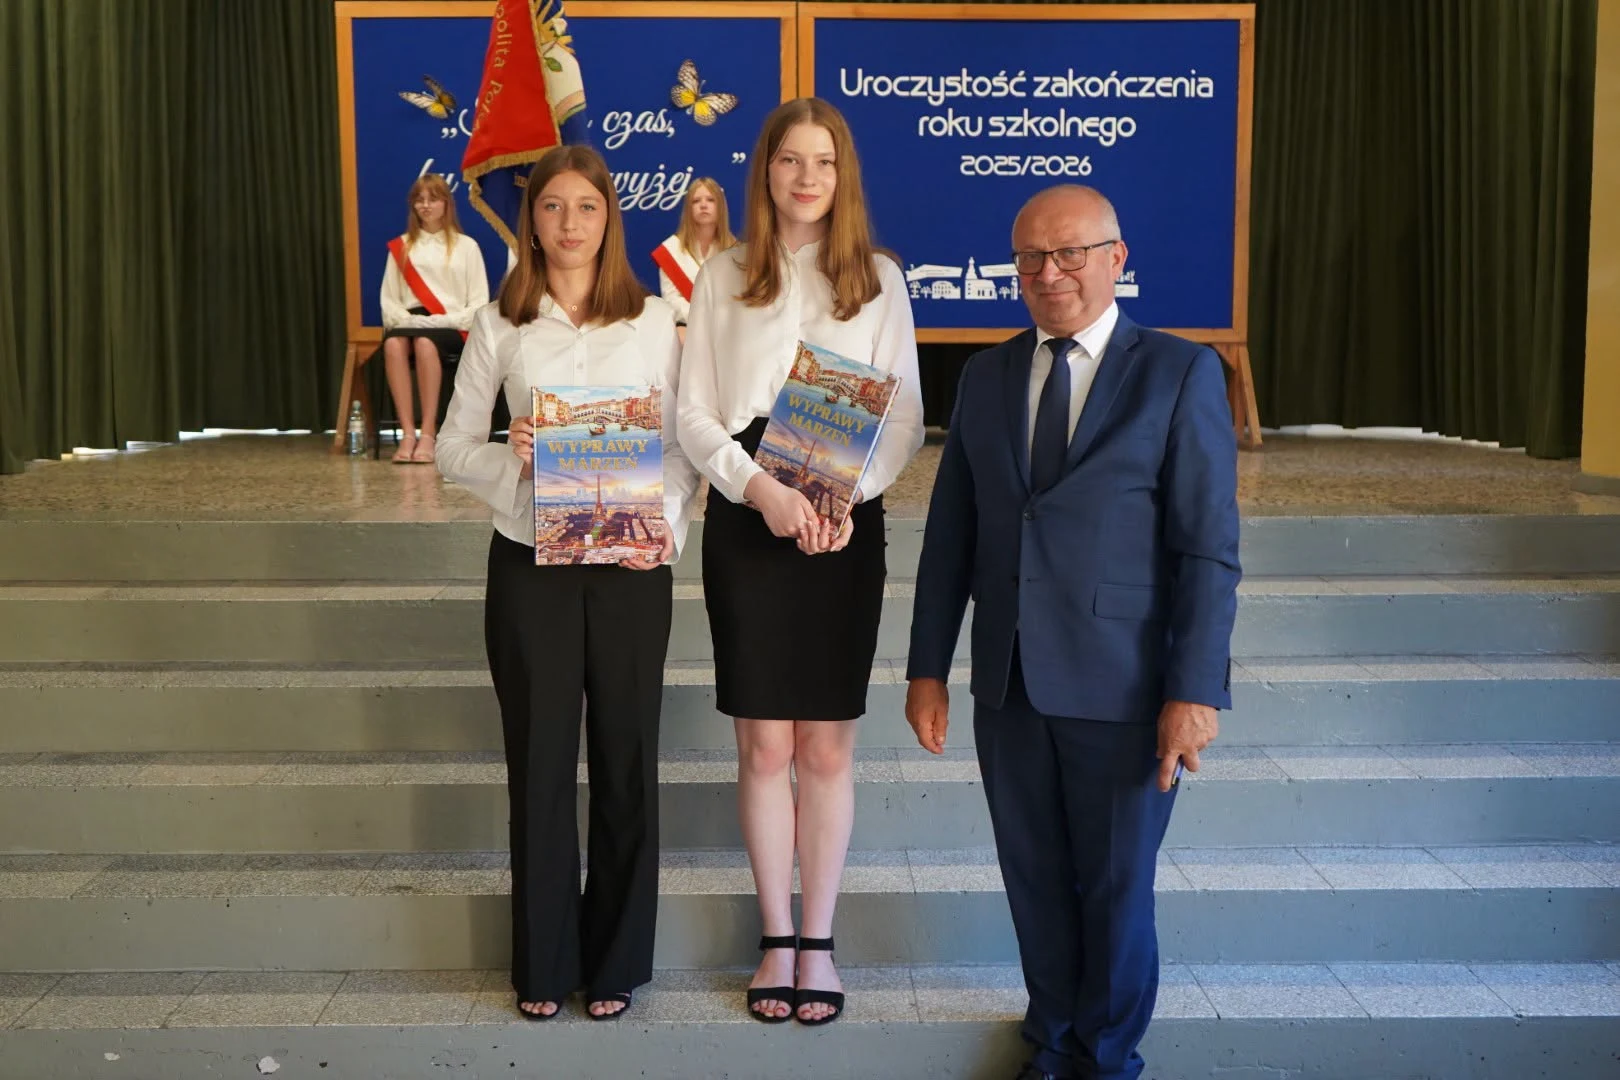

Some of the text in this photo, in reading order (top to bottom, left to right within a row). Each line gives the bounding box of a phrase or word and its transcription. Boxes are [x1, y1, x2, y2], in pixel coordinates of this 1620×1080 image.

[840, 67, 1214, 106] Uroczystość zakończenia
[602, 108, 675, 150] czas,
[918, 108, 1137, 147] roku szkolnego
[959, 155, 1092, 176] 2025/2026
[788, 393, 866, 433] WYPRAWY
[788, 412, 852, 448] MARZEŃ
[547, 439, 649, 454] WYPRAWY
[558, 451, 639, 471] MARZEŃ
